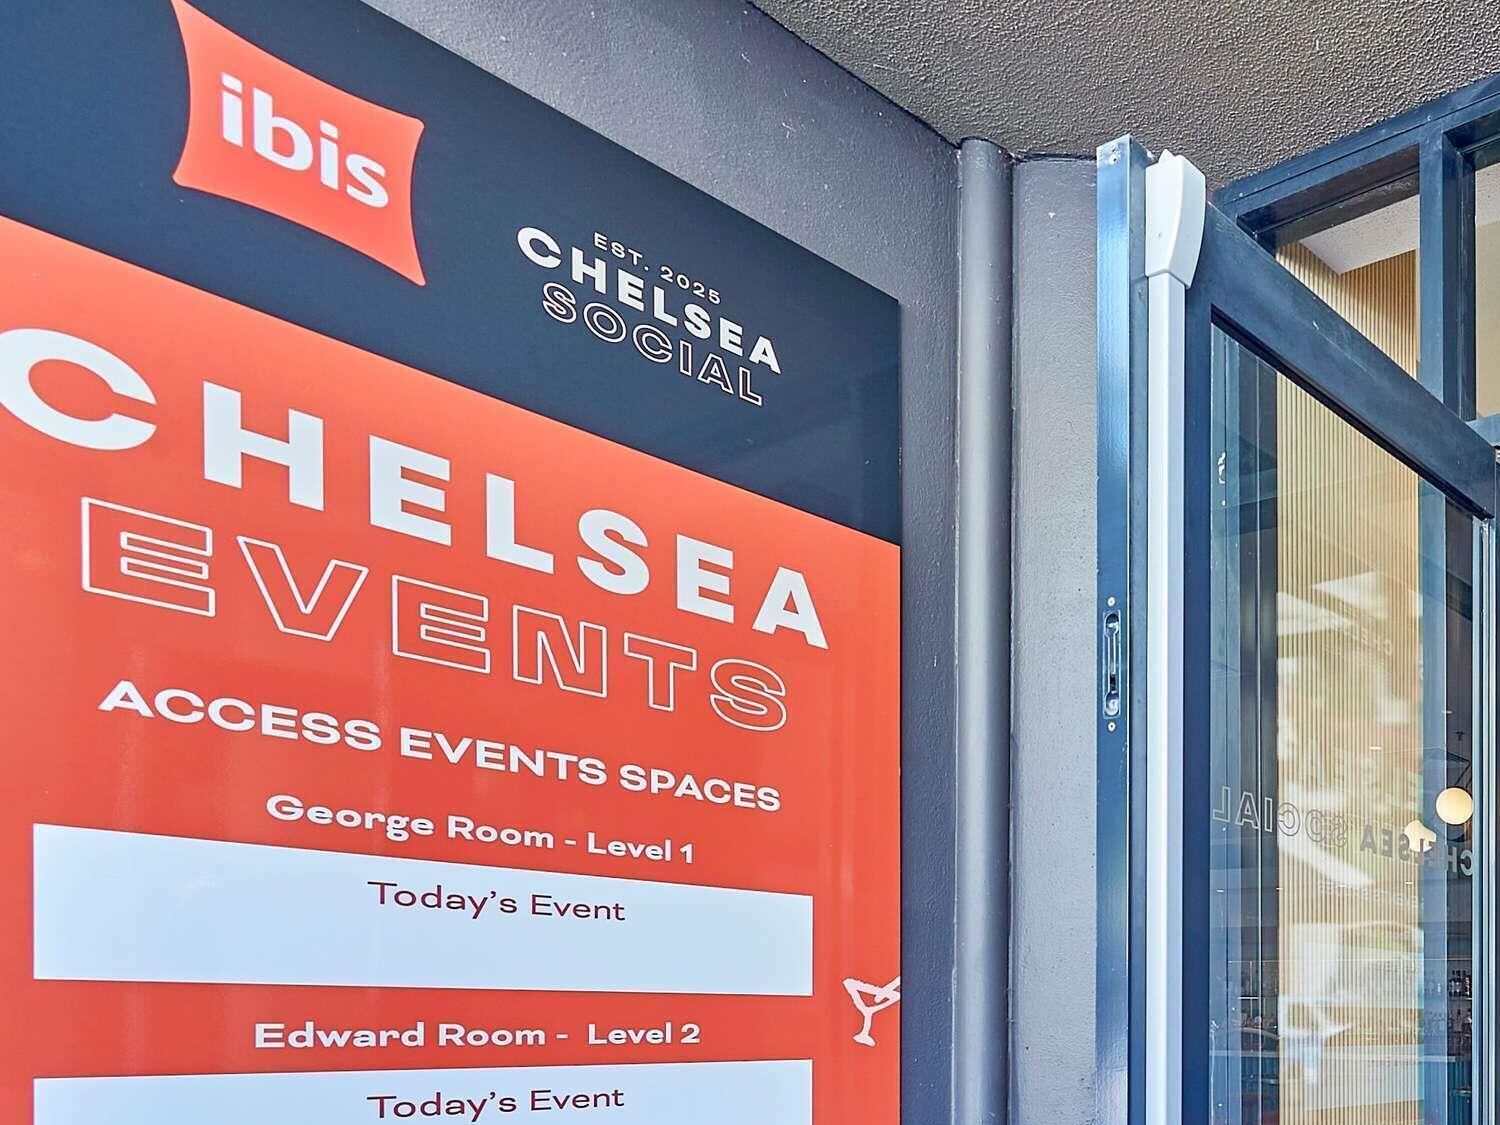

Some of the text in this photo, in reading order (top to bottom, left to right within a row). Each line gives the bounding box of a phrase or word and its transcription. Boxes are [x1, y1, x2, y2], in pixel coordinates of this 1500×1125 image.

[221, 72, 389, 207] ibis
[518, 227, 781, 373] CHELSEA
[594, 232, 720, 304] EST. 2025
[543, 283, 761, 406] SOCIAL
[0, 328, 828, 649] CHELSEA
[81, 497, 786, 731] EVENTS
[99, 681, 780, 811] ACCESS EVENTS SPACES
[267, 795, 433, 841] George
[448, 816, 553, 848] Room
[588, 832, 671, 861] Level
[680, 844, 692, 863] 1
[368, 882, 625, 920] Today’s Event
[256, 1022, 424, 1047] Edward
[439, 1024, 545, 1045] Room
[589, 1022, 671, 1044] Level
[681, 1024, 699, 1043] 2
[367, 1090, 624, 1122] Today’s Event
